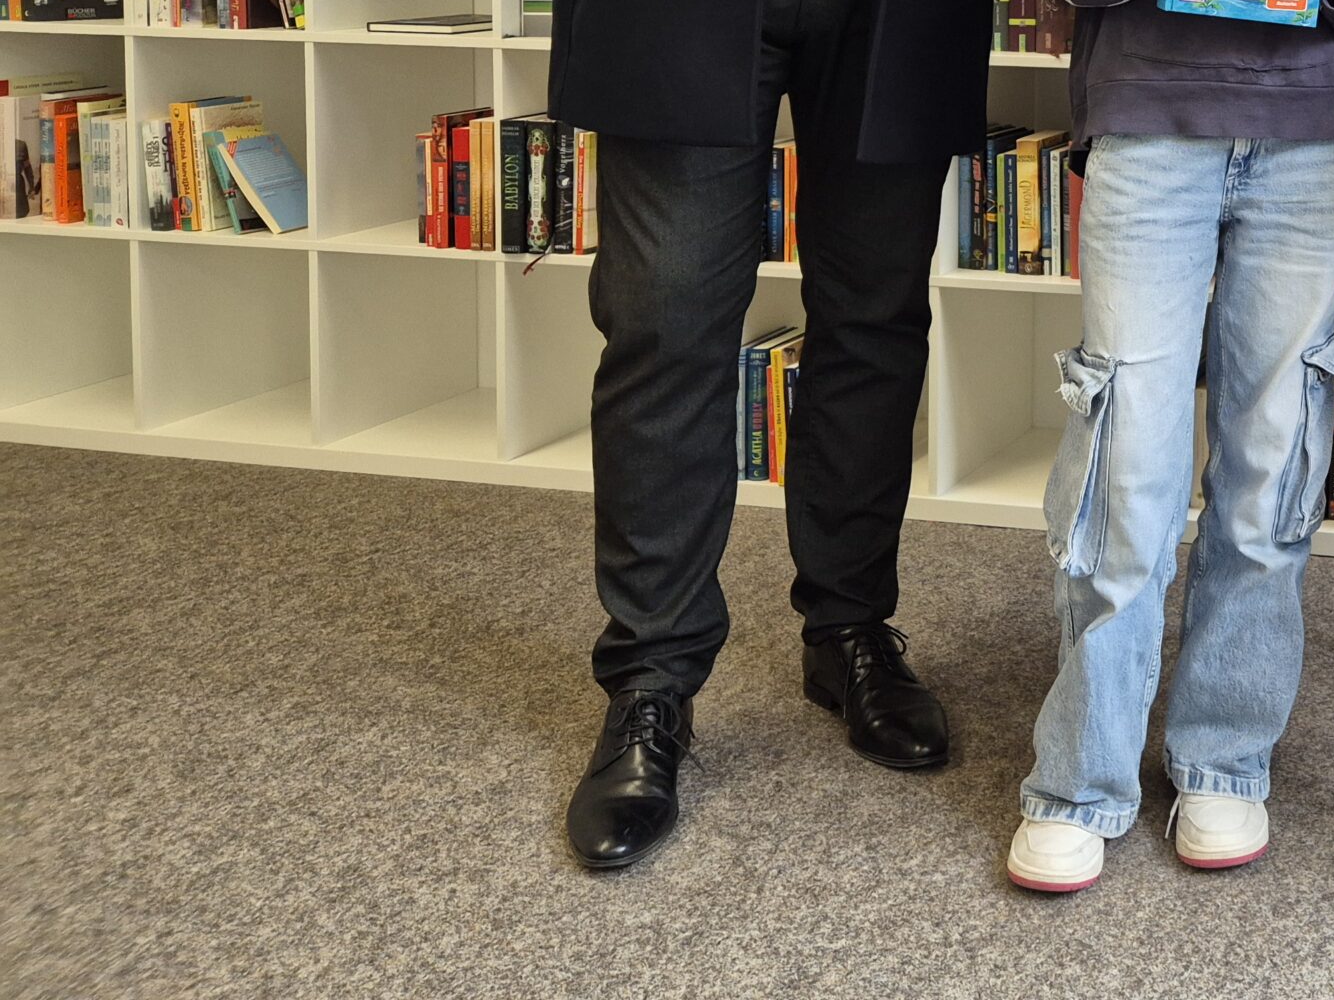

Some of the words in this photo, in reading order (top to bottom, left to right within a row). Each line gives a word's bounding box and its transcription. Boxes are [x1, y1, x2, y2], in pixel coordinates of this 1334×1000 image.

[559, 135, 567, 173] Vogelherz
[505, 154, 519, 210] BABYLON
[1020, 180, 1036, 231] JÄGERMOND
[751, 403, 763, 430] ODDLY
[752, 430, 763, 465] AGATHA
